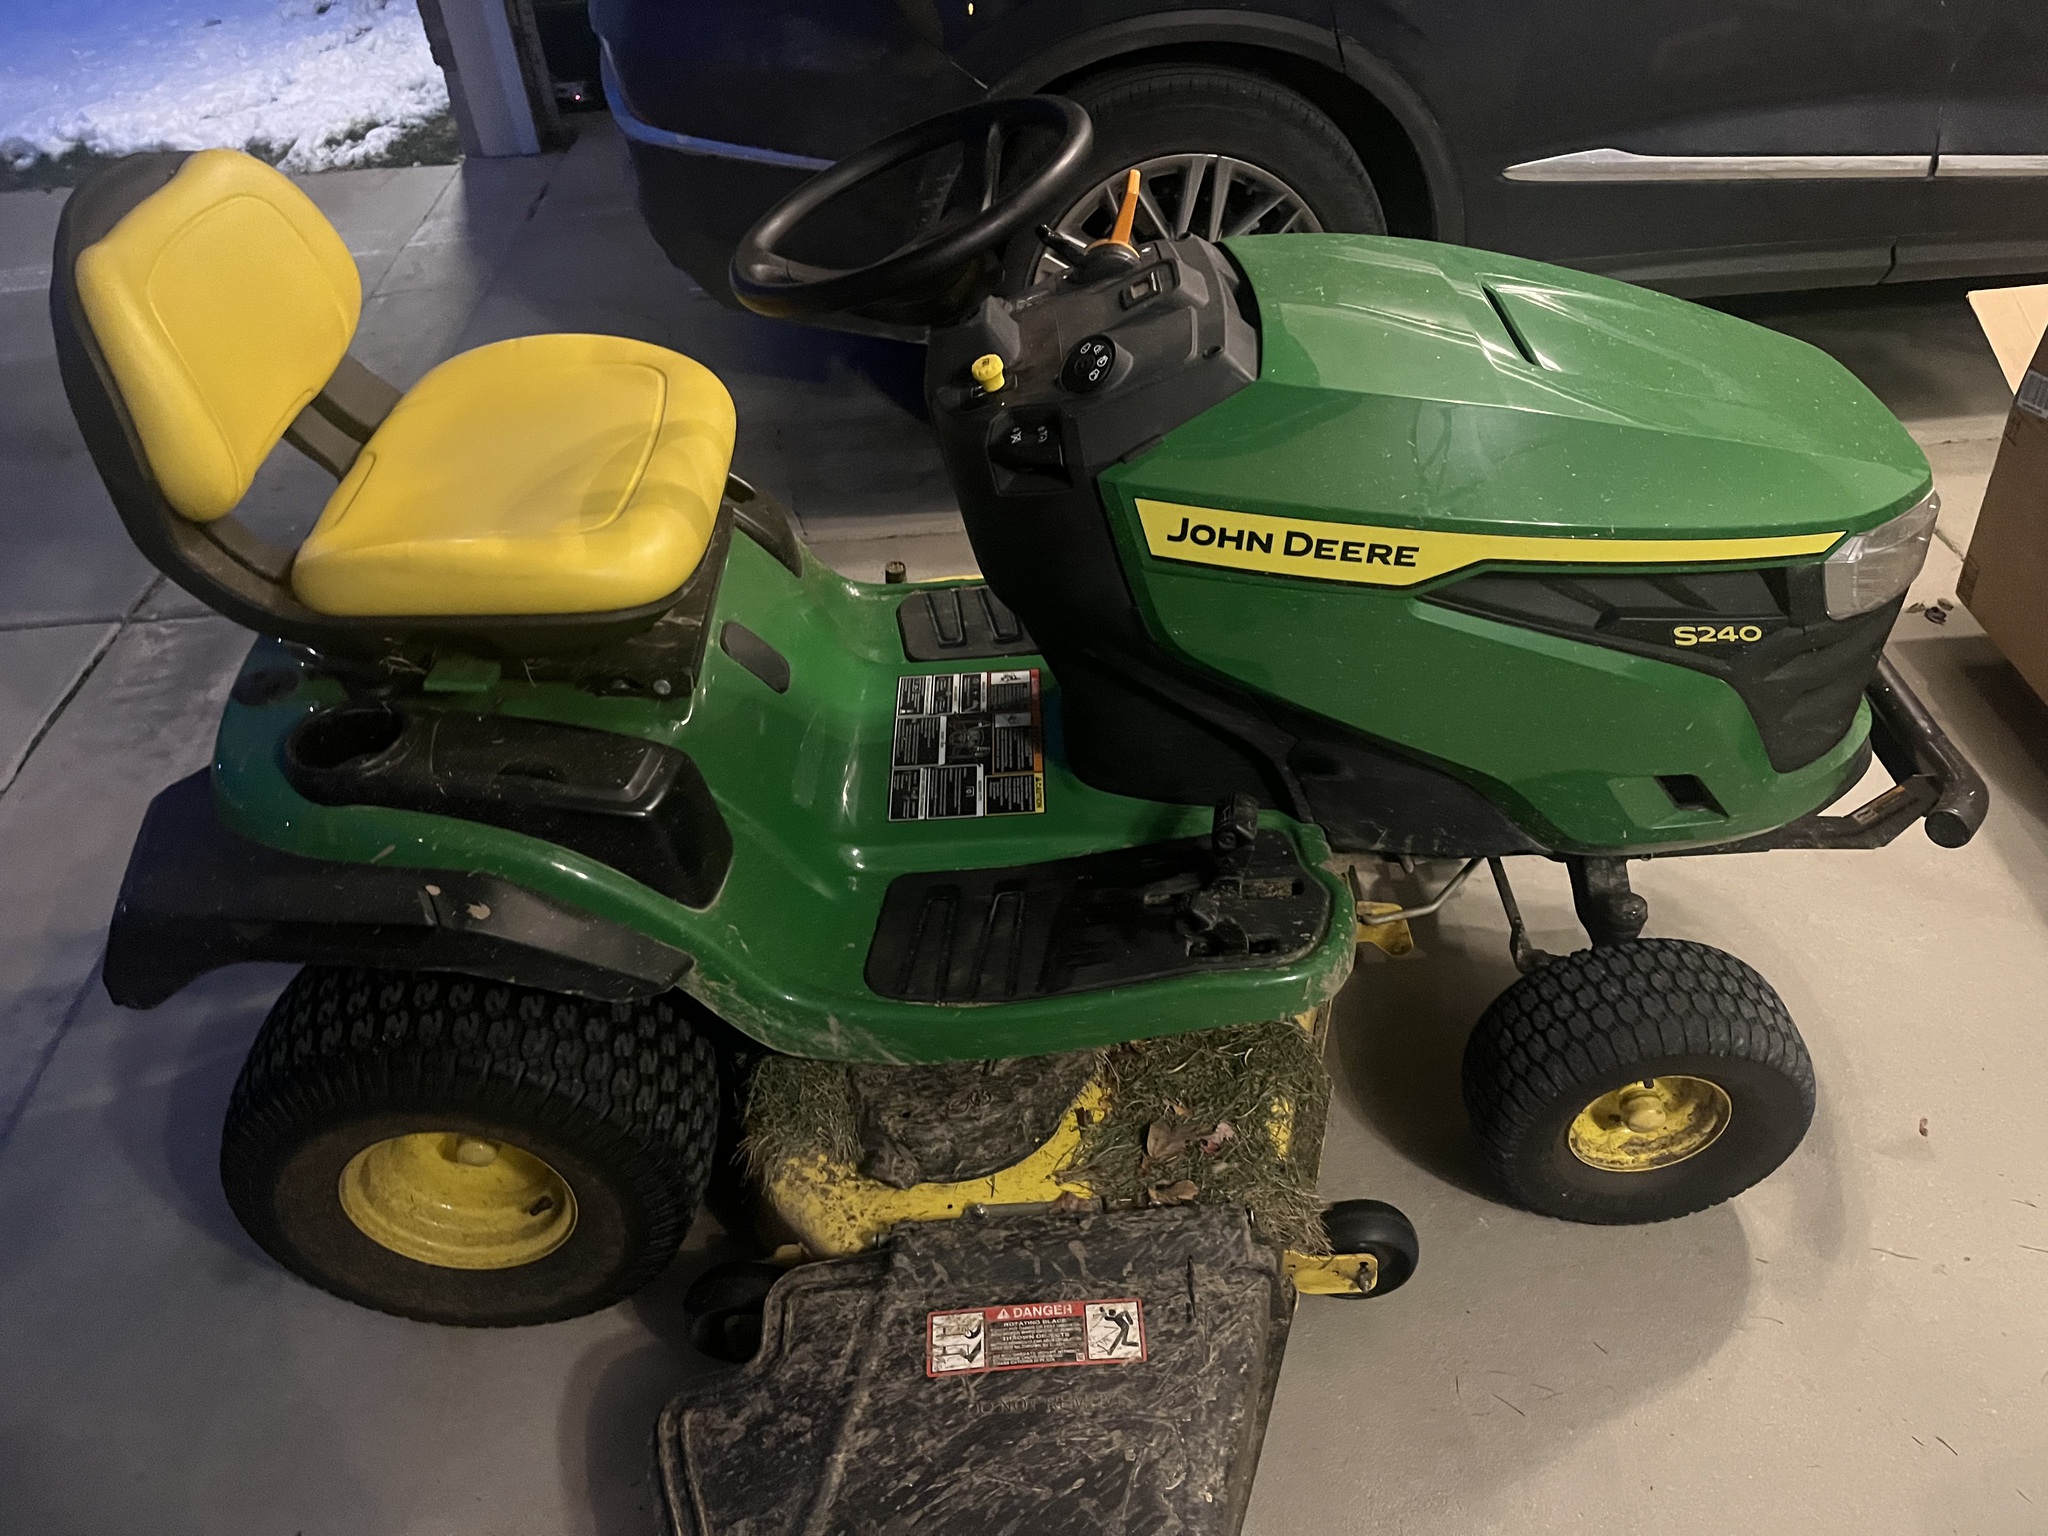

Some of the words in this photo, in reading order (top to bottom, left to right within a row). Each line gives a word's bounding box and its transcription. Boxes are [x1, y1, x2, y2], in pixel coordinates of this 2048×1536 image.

[1166, 518, 1274, 554] JOHN
[1283, 530, 1420, 568] DEERE
[1673, 625, 1762, 646] S240
[1012, 1304, 1072, 1318] DANGER
